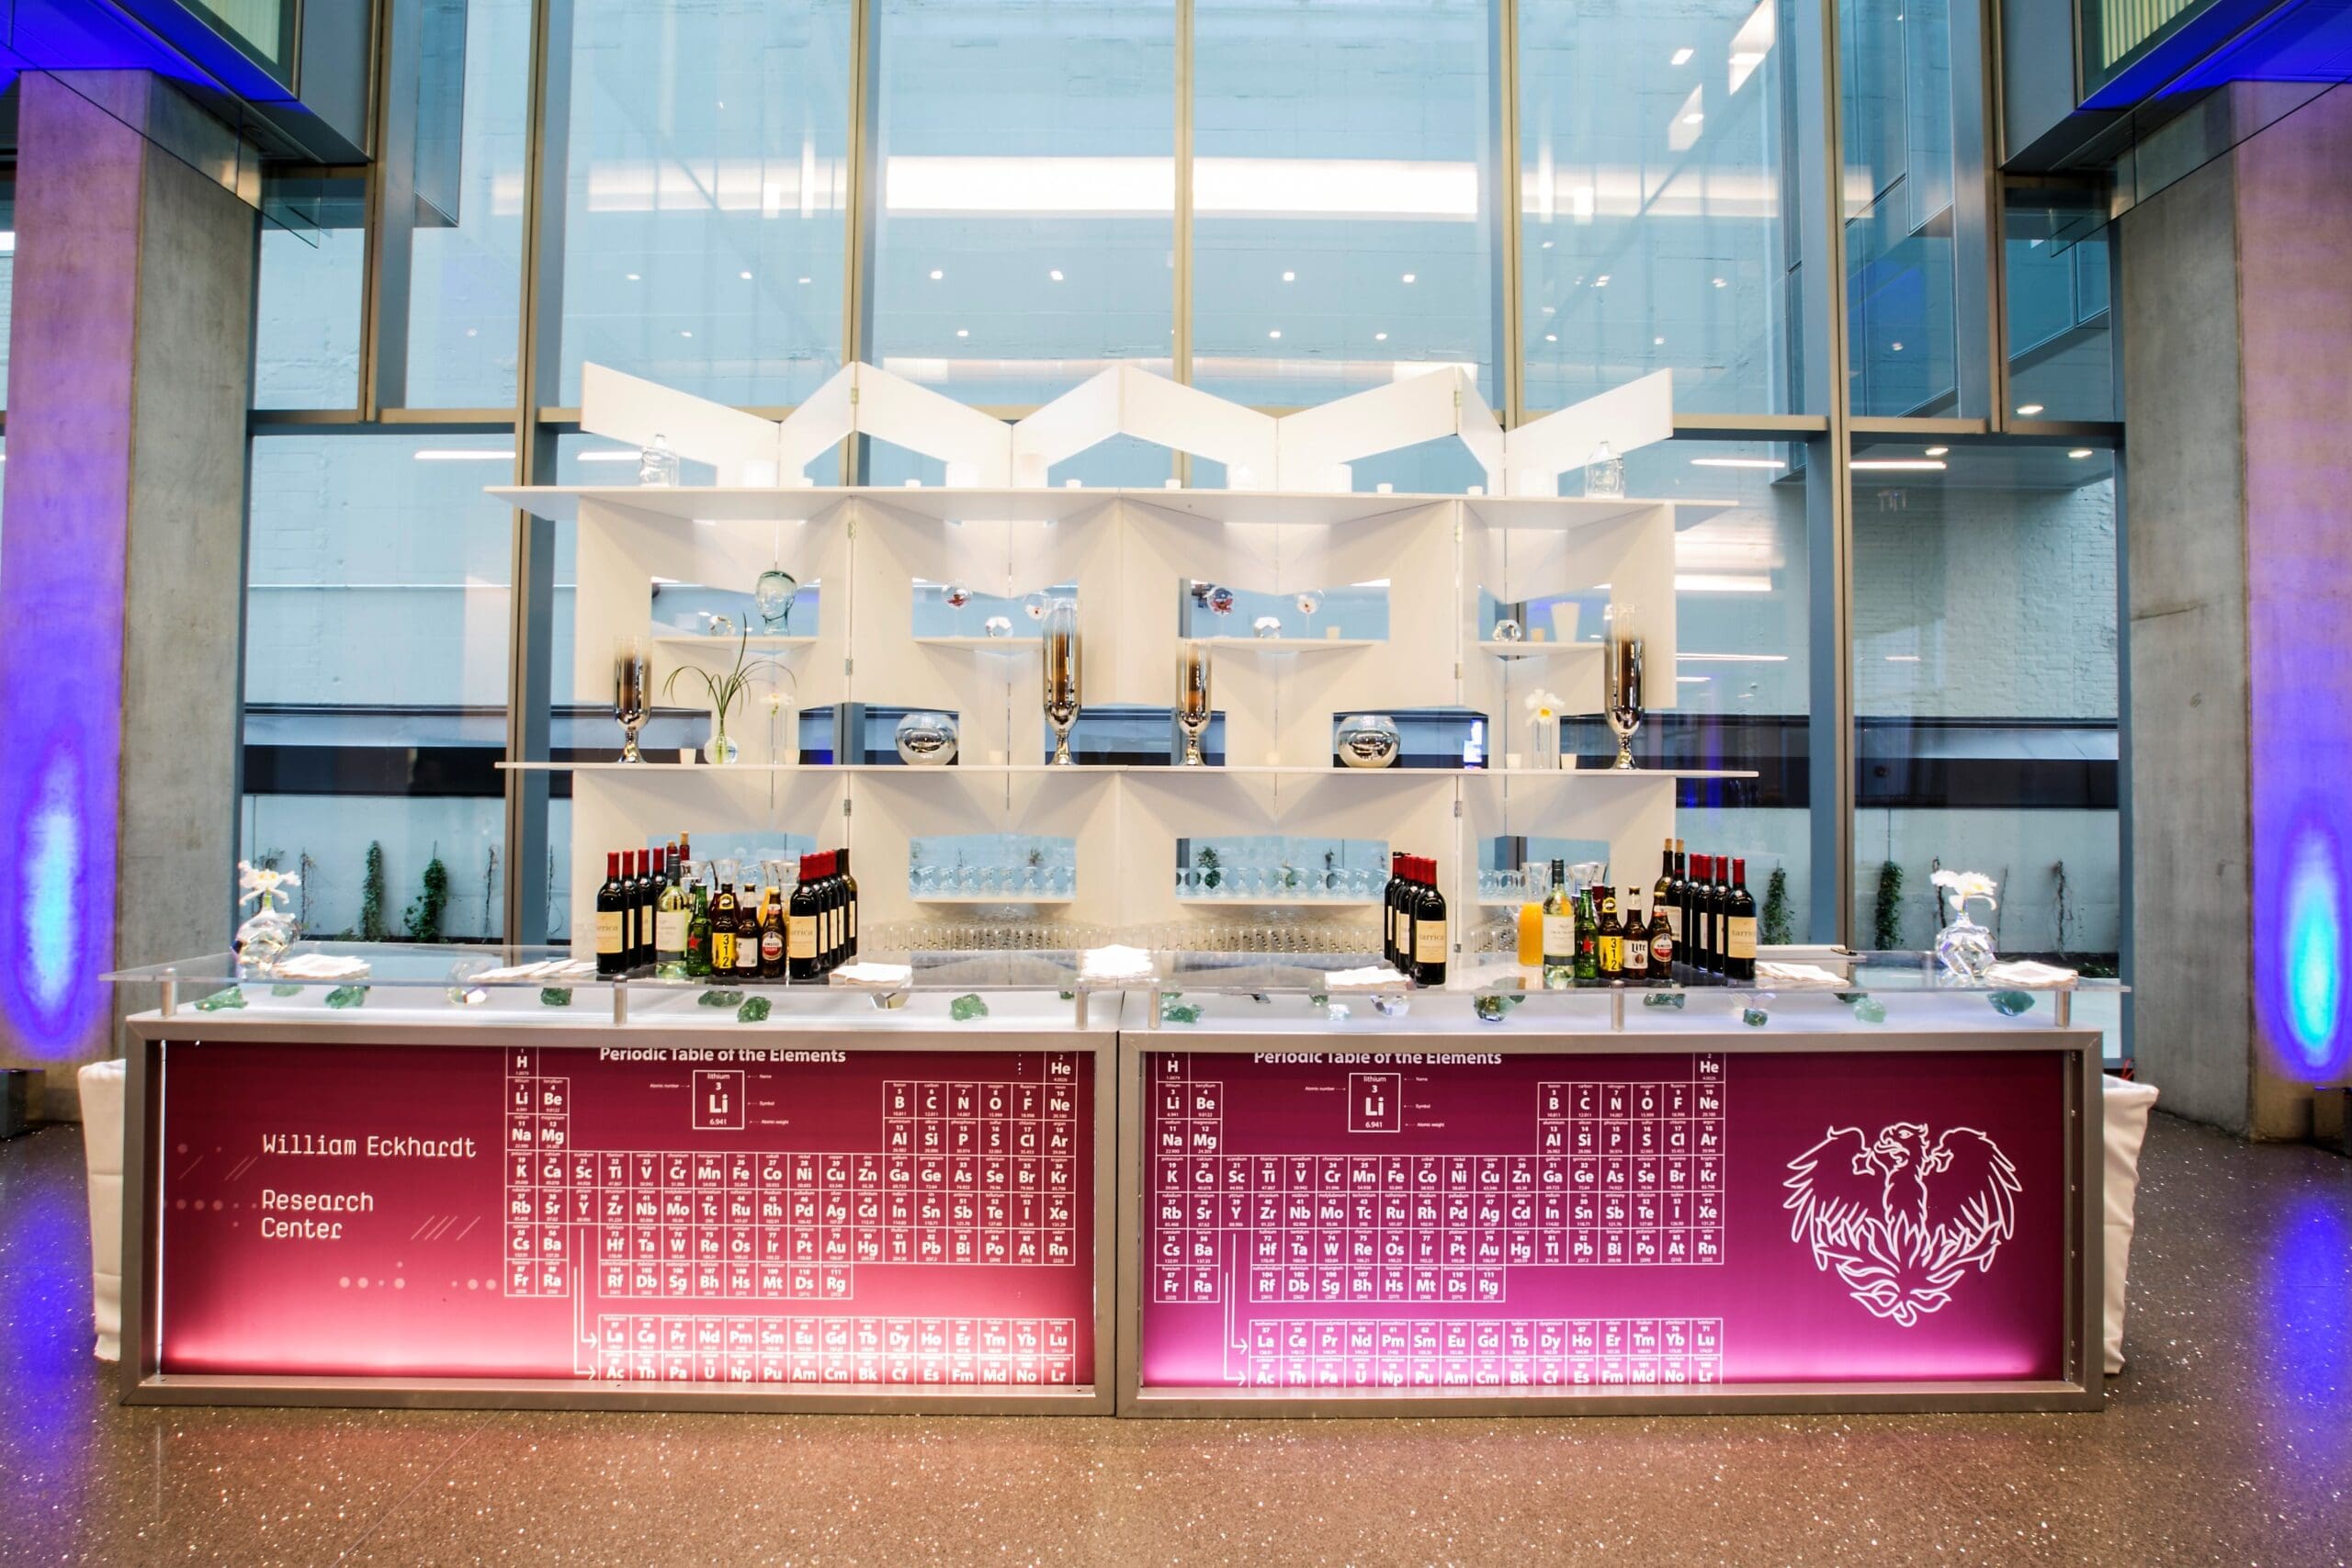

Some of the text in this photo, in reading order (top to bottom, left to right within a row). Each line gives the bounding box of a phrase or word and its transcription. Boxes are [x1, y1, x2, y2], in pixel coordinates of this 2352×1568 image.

[600, 1047, 846, 1063] Periodic Table of the Elements
[517, 1056, 527, 1068] H
[1051, 1062, 1071, 1075] He
[1168, 1060, 1178, 1072] H
[1700, 1061, 1719, 1073] He
[715, 1082, 722, 1090] 3
[1372, 1085, 1378, 1093] 3
[516, 1092, 528, 1105] Li
[544, 1092, 562, 1105] Be
[709, 1094, 728, 1113] Li
[895, 1096, 905, 1109] B
[926, 1096, 937, 1109] C
[958, 1097, 969, 1109] N
[989, 1097, 1002, 1110] O
[1024, 1098, 1032, 1110] F
[1050, 1098, 1070, 1111] Ne
[1167, 1097, 1179, 1109] Li
[1196, 1097, 1215, 1110] Be
[1550, 1098, 1559, 1110] B
[1580, 1098, 1590, 1110] C
[1611, 1098, 1622, 1110] N
[1641, 1097, 1653, 1110] O
[1674, 1097, 1682, 1109] F
[1700, 1097, 1719, 1109] Ne
[1365, 1096, 1384, 1116] Li
[512, 1128, 531, 1141] Na
[541, 1129, 564, 1145] Mg
[892, 1132, 907, 1145] Al
[925, 1133, 938, 1145] Si
[959, 1133, 968, 1146] P
[991, 1134, 1000, 1146] S
[1020, 1134, 1034, 1147] Cl
[1051, 1135, 1068, 1147] Ar
[1163, 1134, 1182, 1146] Na
[1546, 1134, 1560, 1146] Al
[1578, 1134, 1591, 1146] Si
[1611, 1134, 1621, 1146] P
[1643, 1134, 1651, 1146] S
[1671, 1133, 1685, 1146] Cl
[1700, 1133, 1717, 1146] Ar
[263, 1134, 476, 1158] William Eckhardt
[1193, 1134, 1216, 1150] Mg
[517, 1165, 527, 1177] K
[543, 1165, 561, 1178] Ca
[576, 1165, 592, 1179] Sc
[608, 1166, 622, 1179] Ti
[641, 1166, 652, 1179] V
[670, 1166, 686, 1179] Cr
[698, 1167, 721, 1179] Mn
[733, 1167, 750, 1180] Fe
[763, 1167, 782, 1180] Co
[797, 1168, 812, 1180] Ni
[826, 1168, 845, 1181] Cu
[858, 1168, 877, 1181] Zn
[889, 1169, 909, 1181] Ga
[921, 1169, 942, 1182] Ge
[954, 1170, 972, 1182] As
[987, 1170, 1004, 1183] Se
[1019, 1170, 1035, 1183] Br
[1051, 1171, 1067, 1183] Kr
[1167, 1170, 1177, 1183] K
[1195, 1170, 1213, 1183] Ca
[1229, 1170, 1245, 1183] Sc
[1262, 1170, 1275, 1183] Ti
[1295, 1170, 1306, 1182] V
[1325, 1170, 1341, 1182] Cr
[1353, 1170, 1375, 1182] Mn
[1388, 1170, 1404, 1183] Fe
[1418, 1170, 1437, 1183] Co
[1452, 1171, 1466, 1182] Ni
[1481, 1171, 1499, 1183] Cu
[1512, 1170, 1530, 1182] Zn
[1543, 1170, 1563, 1183] Ga
[1575, 1170, 1594, 1182] Ge
[1606, 1170, 1624, 1183] As
[1638, 1170, 1655, 1183] Se
[1670, 1169, 1686, 1182] Br
[1701, 1169, 1717, 1182] Kr
[262, 1189, 373, 1212] Research
[512, 1200, 531, 1214] Rb
[579, 1202, 589, 1215] Y
[667, 1203, 690, 1216] Mo
[827, 1205, 845, 1221] Ag
[922, 1205, 940, 1218] Sn
[1050, 1207, 1068, 1220] Xe
[1197, 1207, 1212, 1220] Sr
[1290, 1206, 1311, 1219] Nb
[1512, 1207, 1530, 1219] Cd
[1675, 1206, 1679, 1218] I
[261, 1217, 343, 1240] Center
[513, 1237, 530, 1250] Cs
[638, 1238, 655, 1252] Ta
[732, 1239, 750, 1252] Os
[858, 1241, 878, 1257] Hg
[1049, 1243, 1068, 1256] Rn
[1195, 1243, 1213, 1256] Ba
[1324, 1243, 1339, 1256] W
[1451, 1243, 1465, 1255] Pt
[1574, 1242, 1593, 1256] Pb
[1668, 1242, 1685, 1255] At
[514, 1273, 529, 1287] Fr
[607, 1274, 624, 1288] Rf
[1194, 1280, 1212, 1293] Ra
[1385, 1279, 1404, 1292] Hs
[699, 1330, 720, 1343] Nd
[1257, 1335, 1274, 1348] La
